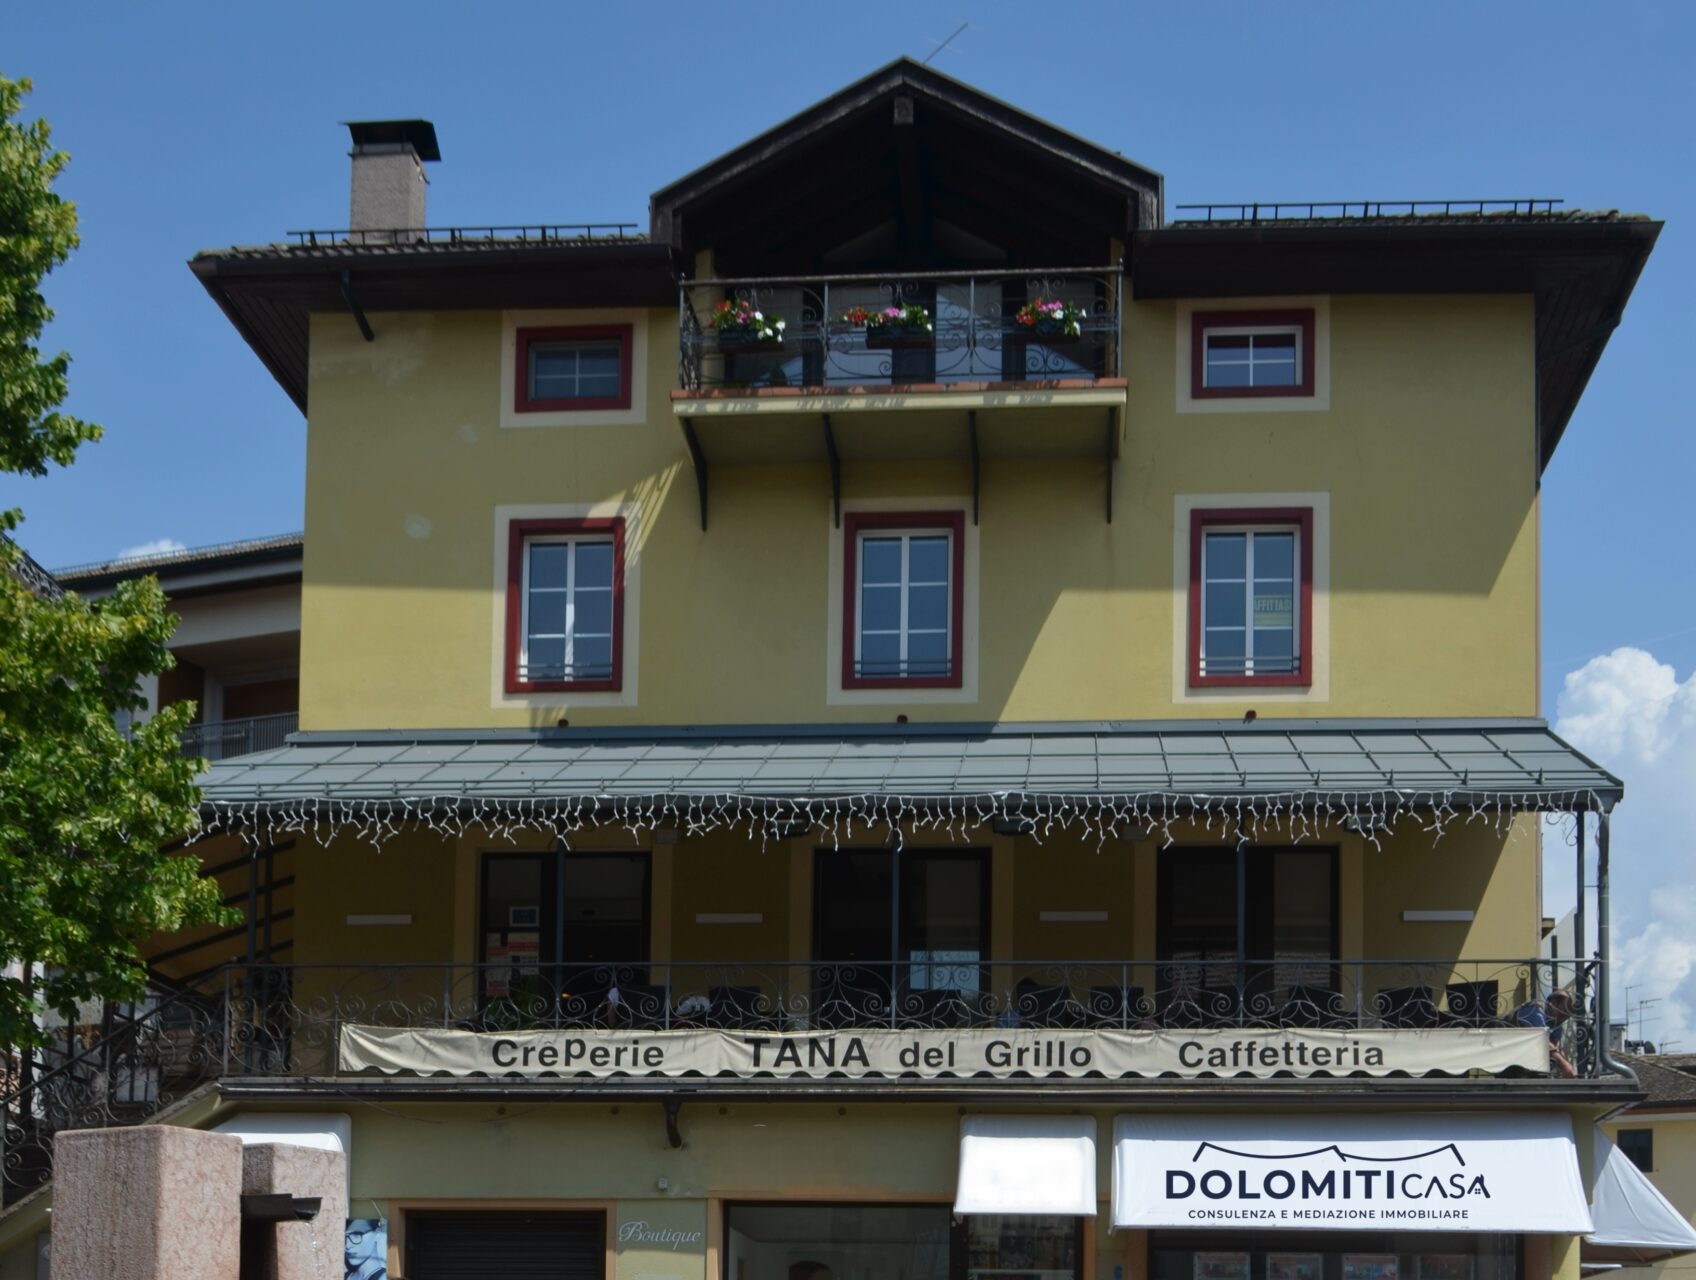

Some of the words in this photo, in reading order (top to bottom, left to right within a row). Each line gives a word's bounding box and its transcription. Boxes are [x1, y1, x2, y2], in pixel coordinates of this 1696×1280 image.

[743, 1037, 870, 1067] TANA
[899, 1041, 955, 1067] del
[984, 1040, 1092, 1067] Grillo
[1178, 1041, 1383, 1067] Caffetteria
[1188, 1209, 1276, 1219] CONSULENZA
[1281, 1209, 1288, 1219] E
[1293, 1209, 1376, 1219] MEDIAZIONE
[1380, 1209, 1469, 1219] IMMOBILIARE
[618, 1220, 701, 1250] Boutique
